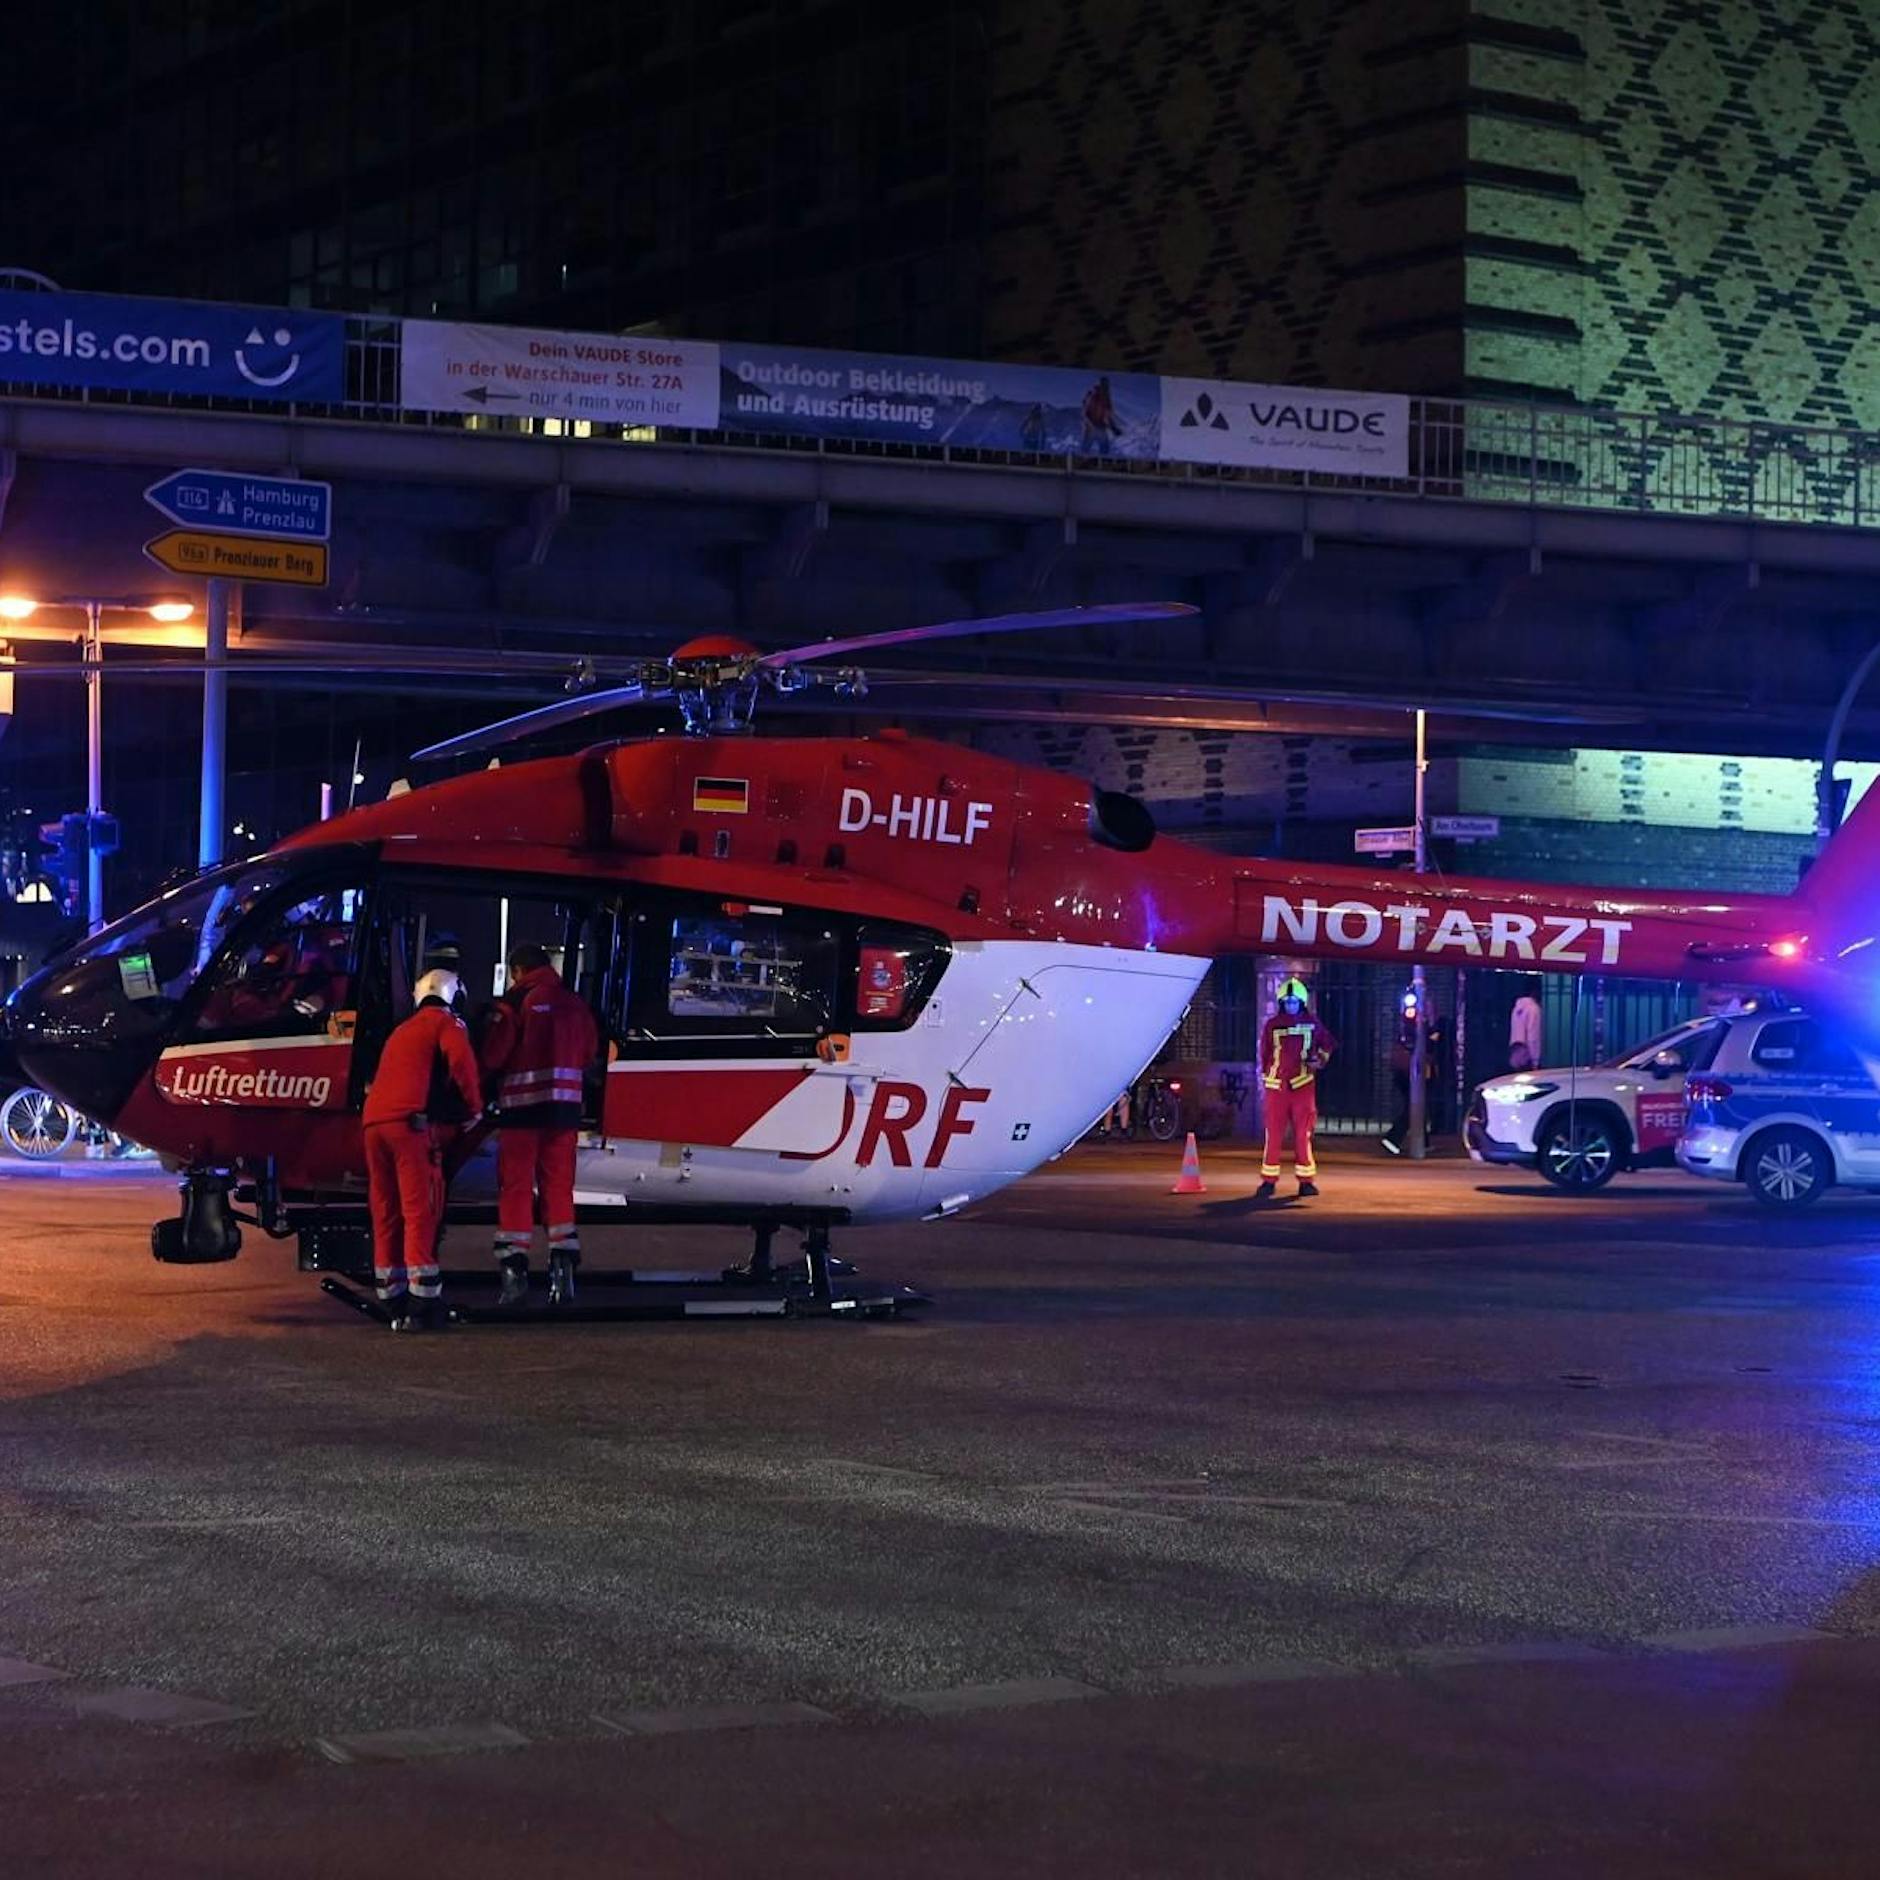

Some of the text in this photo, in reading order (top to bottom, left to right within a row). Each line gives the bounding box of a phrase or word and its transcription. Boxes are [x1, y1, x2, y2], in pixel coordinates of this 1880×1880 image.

[0, 318, 210, 367] stels.com
[529, 341, 683, 367] Dein VAUDE Store
[447, 359, 683, 390] in der Warschauer Str. 27A
[737, 360, 987, 405] Outdoor Bekleidung
[529, 391, 682, 414] nur 4 min von hier
[737, 390, 935, 430] und Ausrüstung
[1250, 402, 1385, 436] VAUDE
[243, 484, 319, 512] Hamburg
[242, 507, 316, 530] Prenzlau
[214, 546, 280, 569] Prenzlauer
[285, 551, 314, 577] Berg
[839, 787, 993, 846] D-HILF
[1261, 895, 1633, 965] NOTARZT
[172, 1065, 332, 1108] Luftrettung
